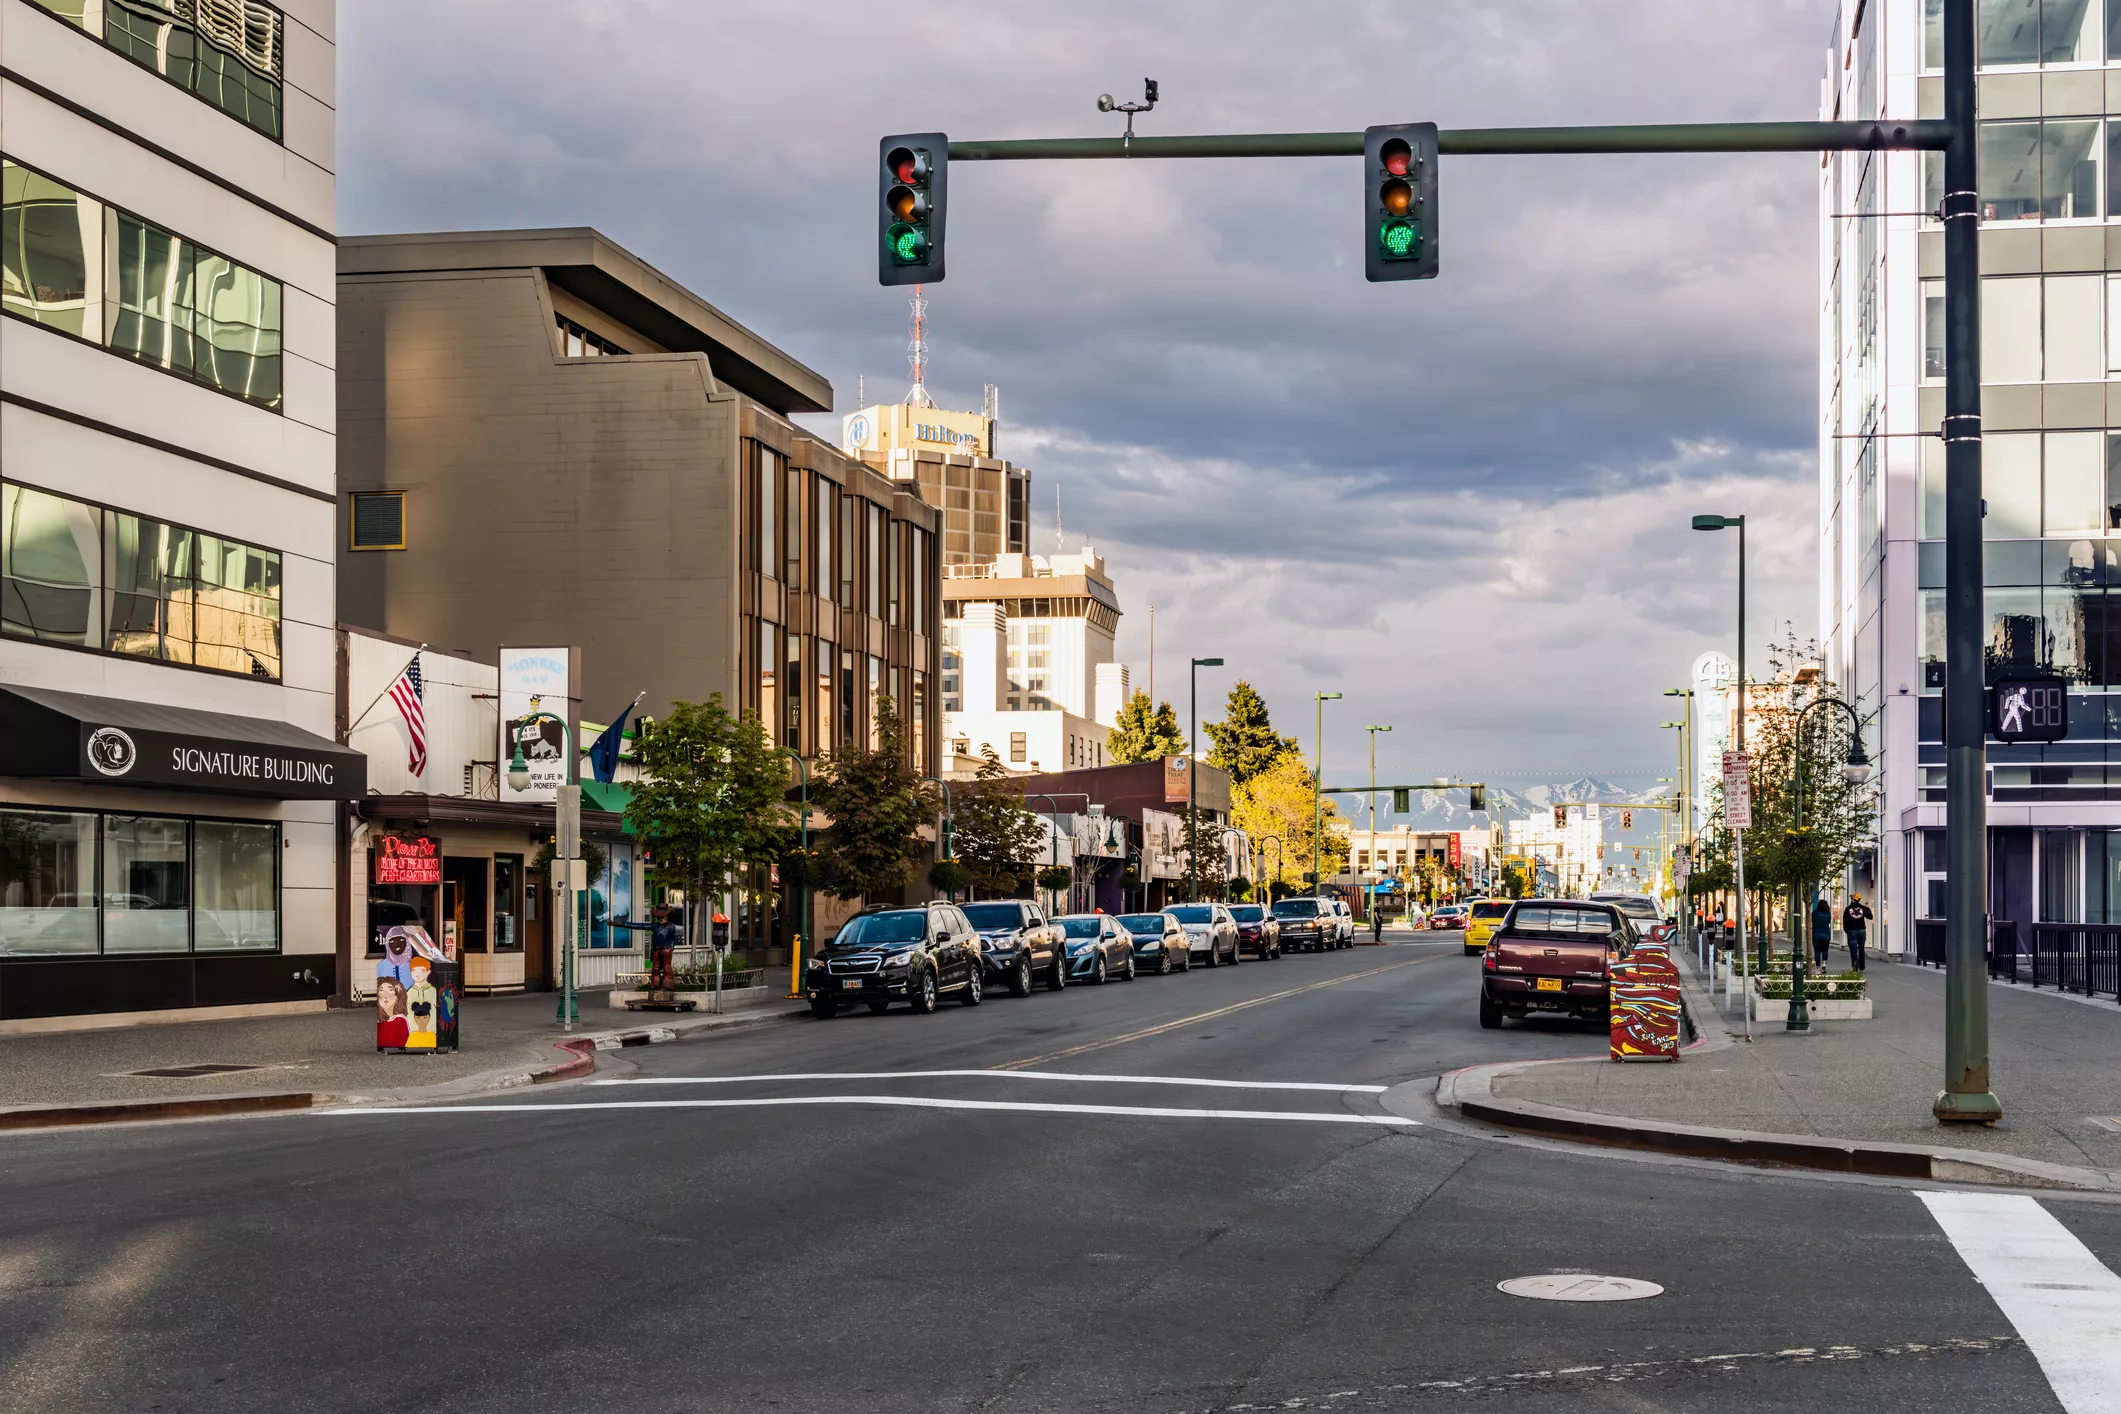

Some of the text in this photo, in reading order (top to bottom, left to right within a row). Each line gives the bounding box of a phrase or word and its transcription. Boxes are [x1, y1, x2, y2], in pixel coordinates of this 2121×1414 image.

[916, 424, 974, 443] Hilton
[172, 747, 334, 785] SIGNATURE BUILDING
